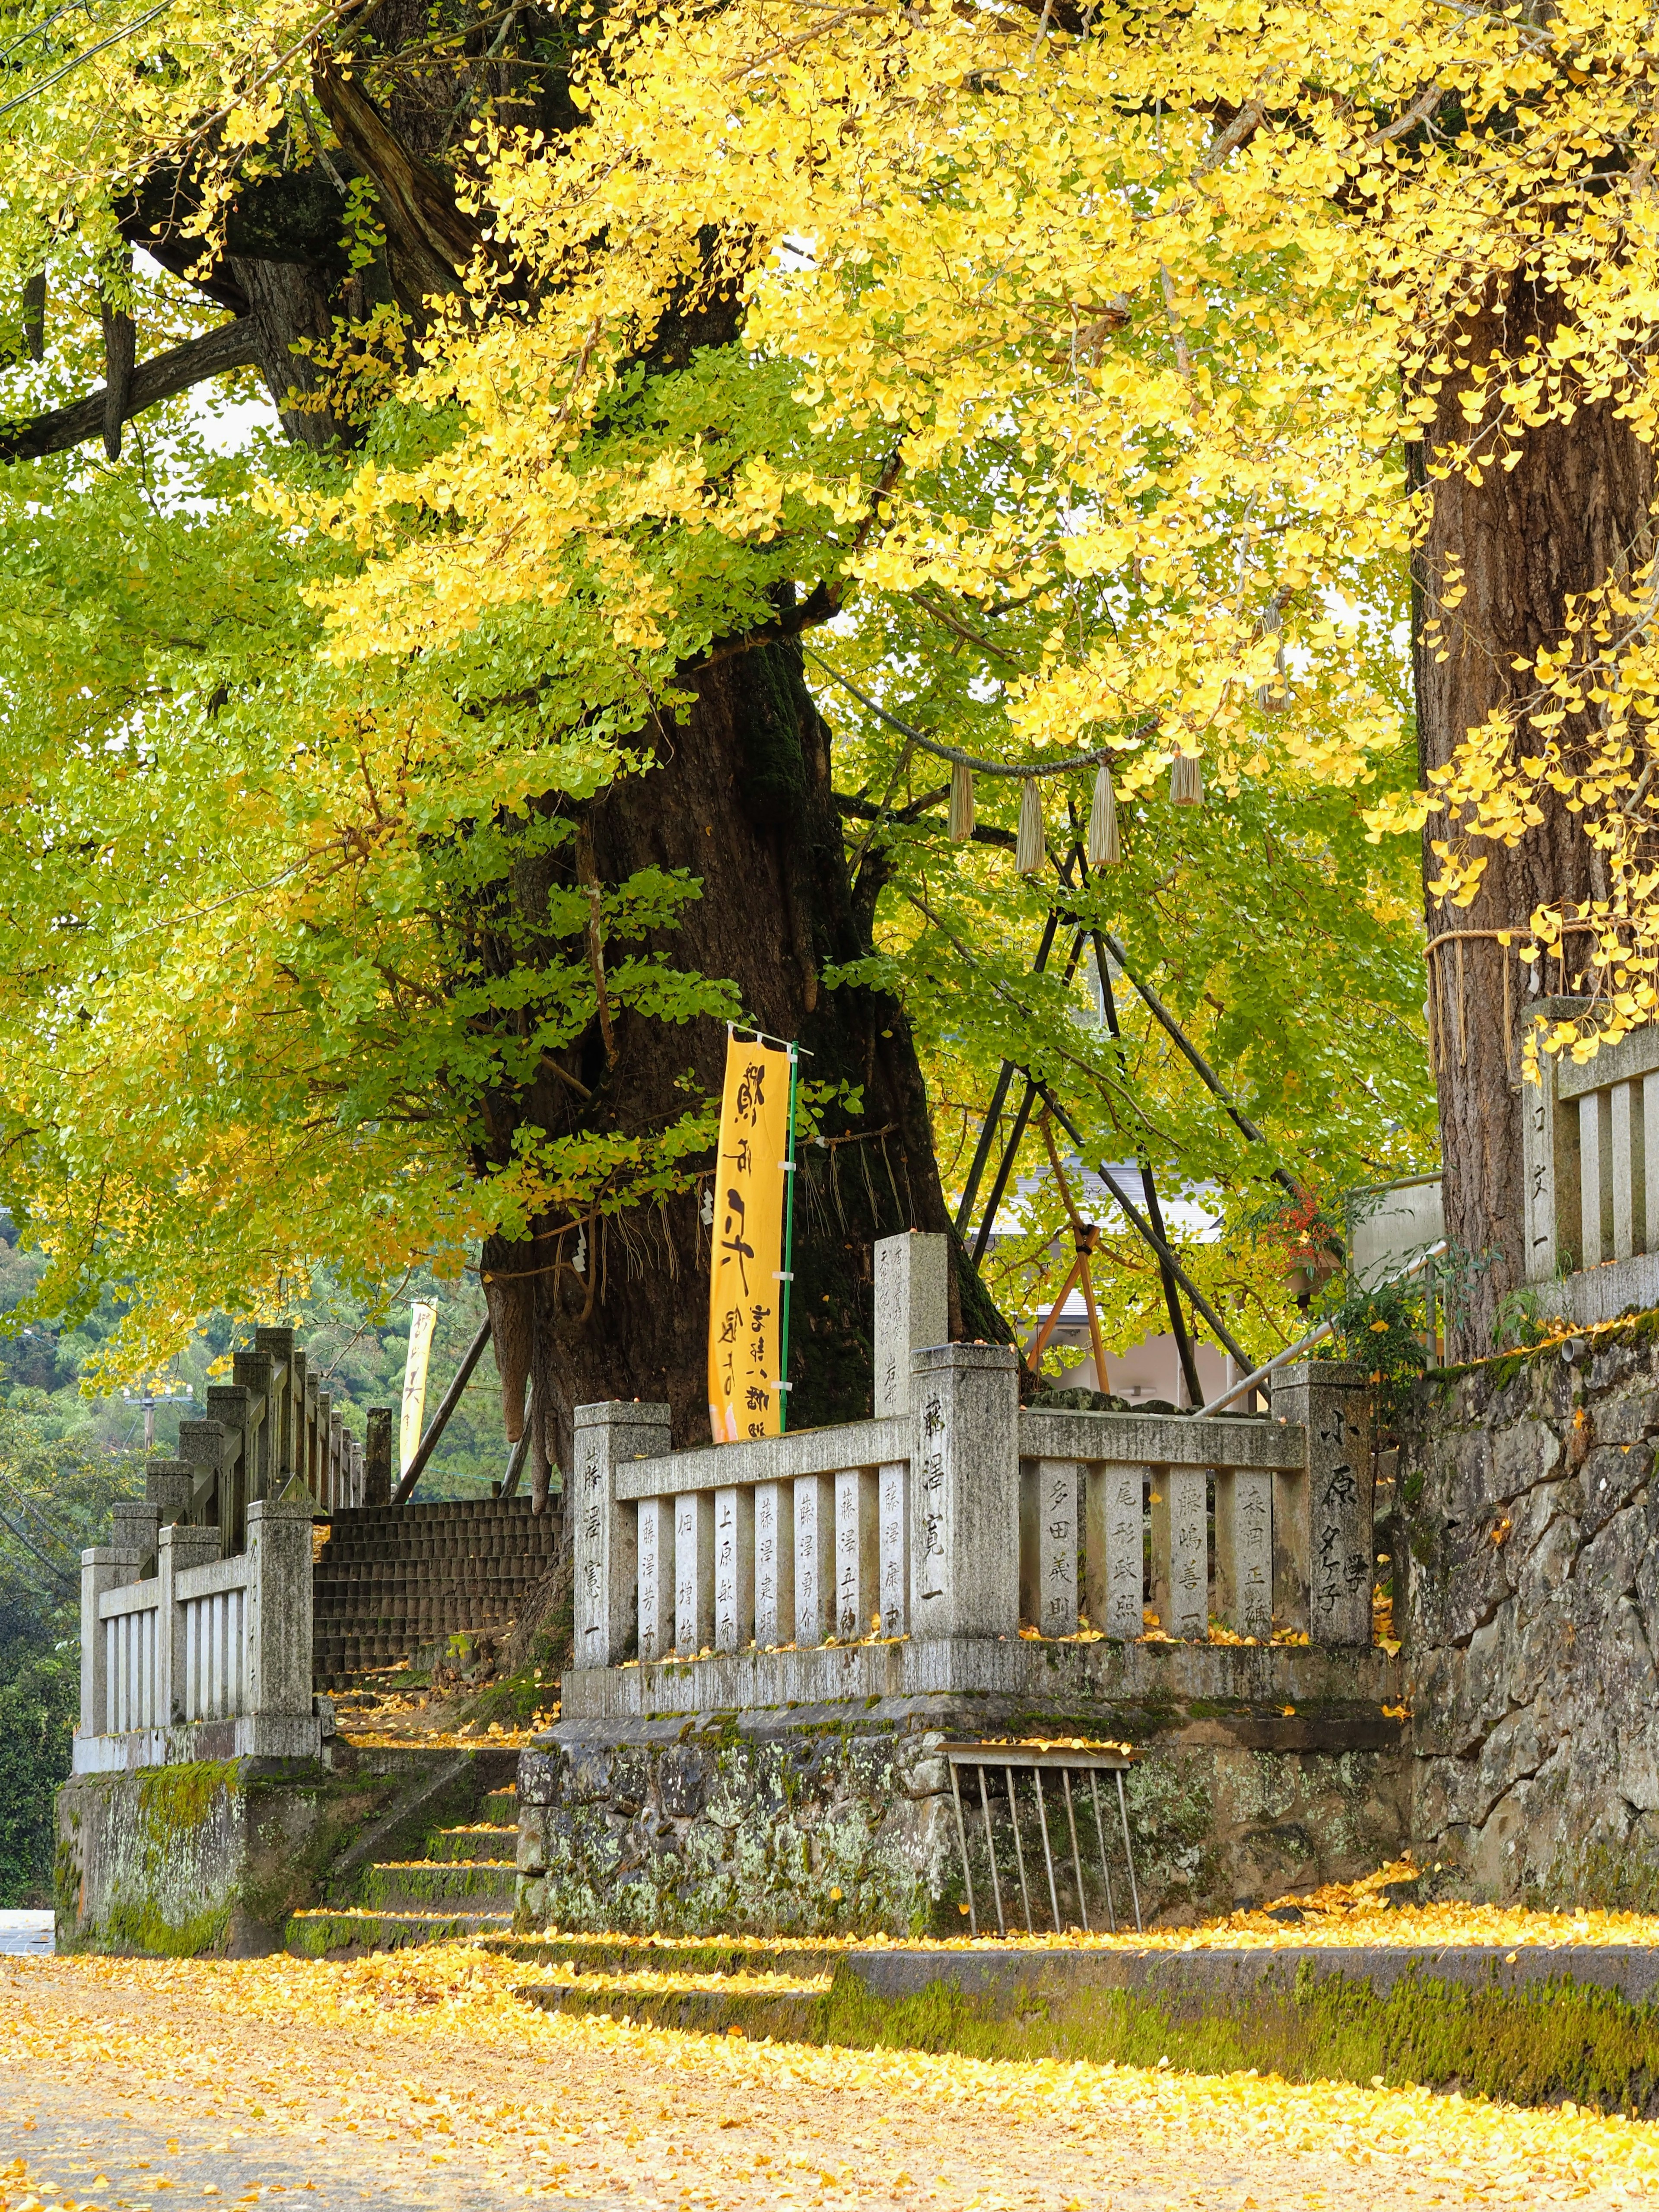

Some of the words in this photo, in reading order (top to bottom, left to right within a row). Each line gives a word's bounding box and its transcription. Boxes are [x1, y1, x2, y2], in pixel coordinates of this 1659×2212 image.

[1532, 1047, 1548, 1248] 口文一
[1048, 1480, 1072, 1620] 多田義則
[1112, 1481, 1137, 1620] 尾形政照
